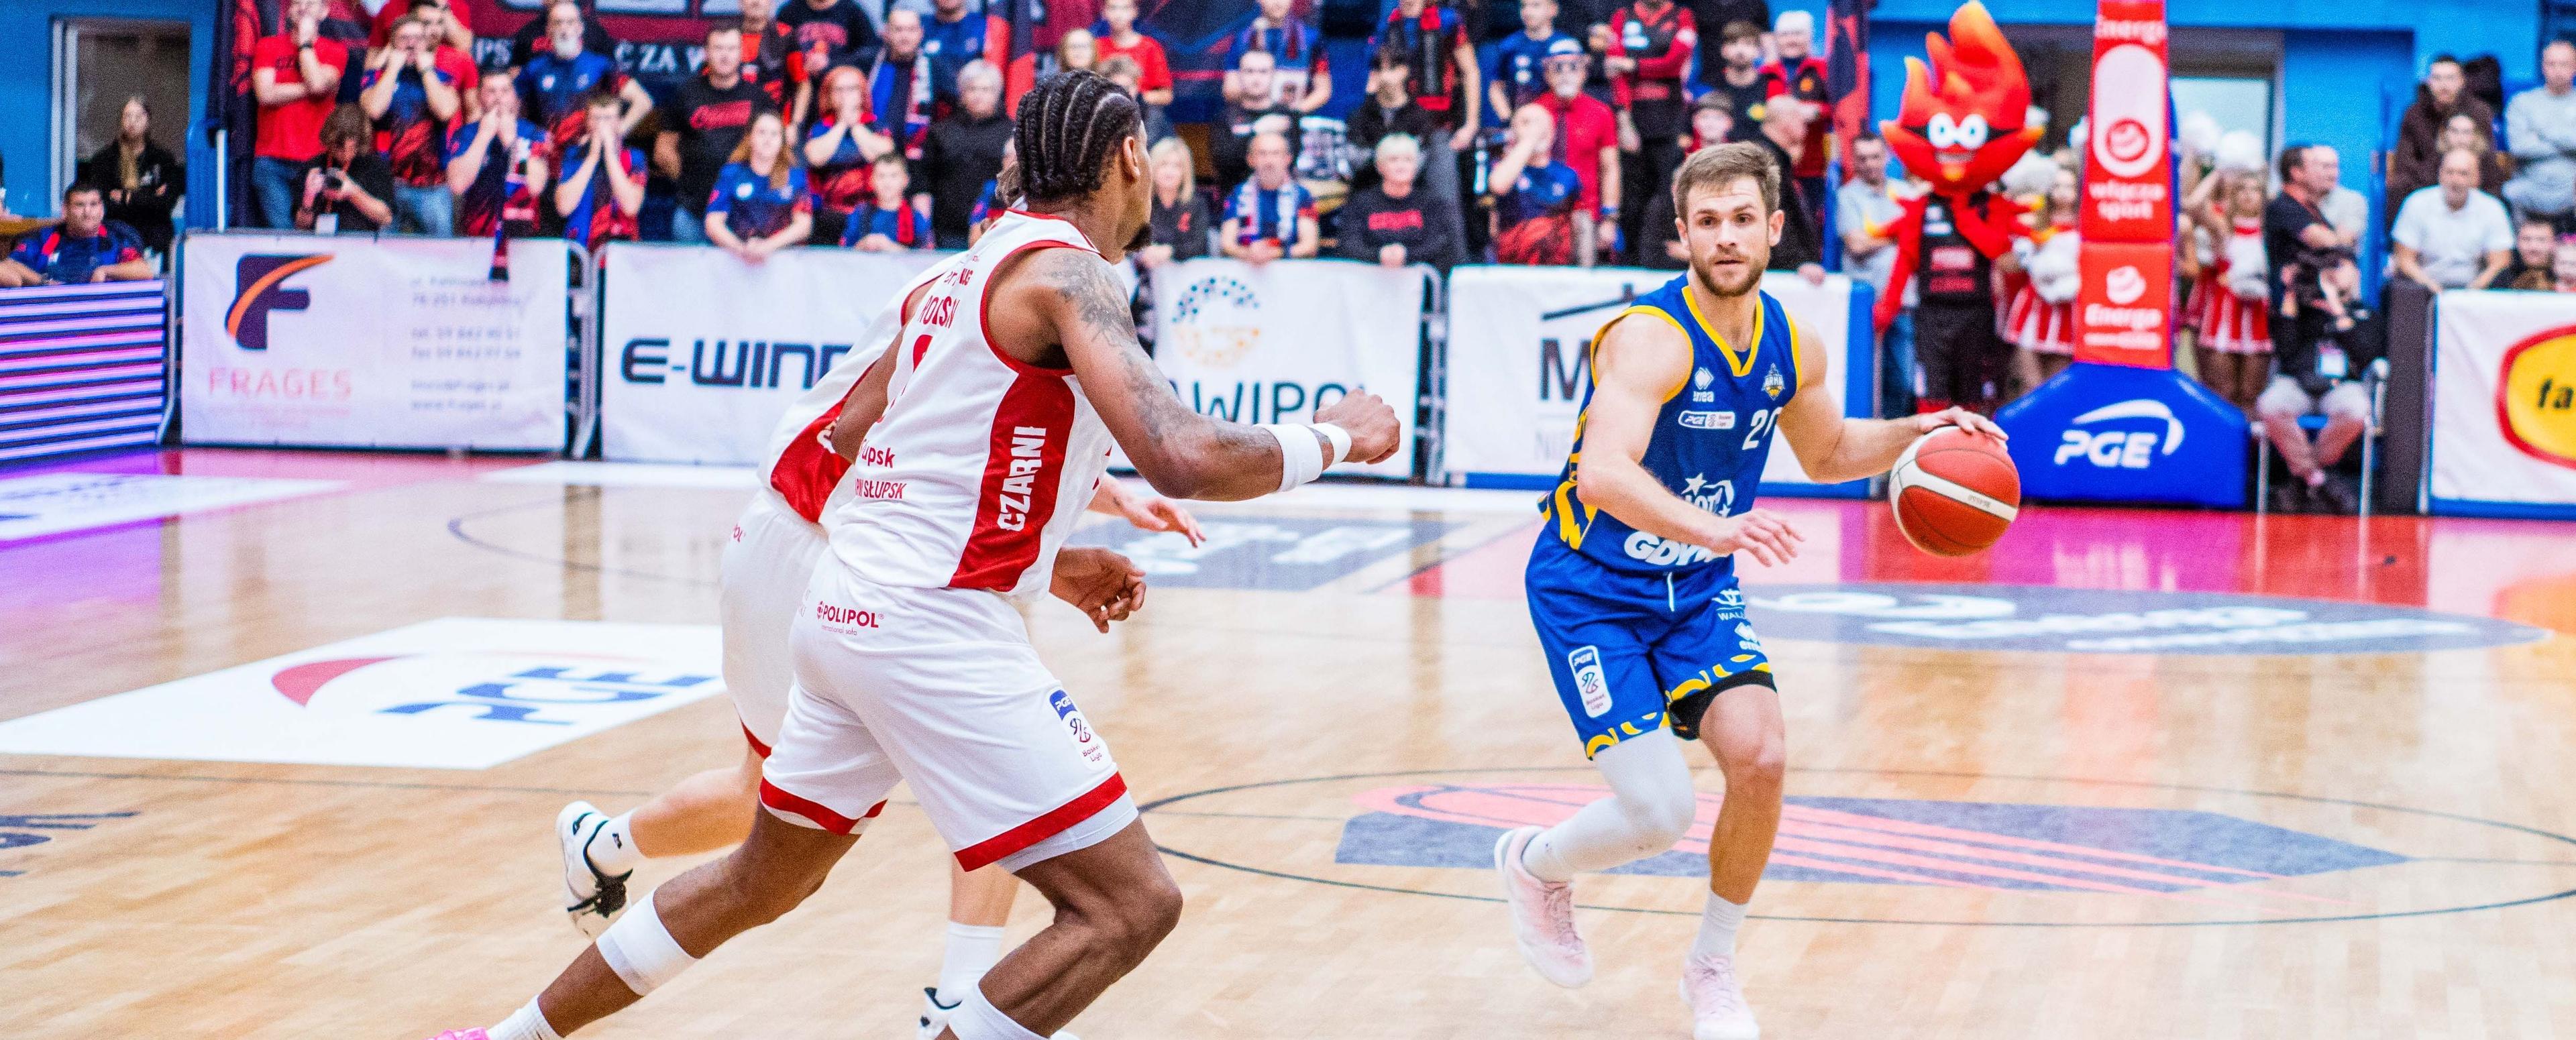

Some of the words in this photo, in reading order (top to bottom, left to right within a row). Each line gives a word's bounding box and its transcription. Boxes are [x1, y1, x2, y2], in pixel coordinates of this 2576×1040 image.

[209, 367, 352, 400] FRAGES
[2054, 429, 2159, 468] PGE
[863, 480, 907, 499] SŁUPSK
[997, 426, 1046, 532] CZARNI
[822, 604, 879, 629] POLIPOL
[1055, 695, 1073, 711] PGE
